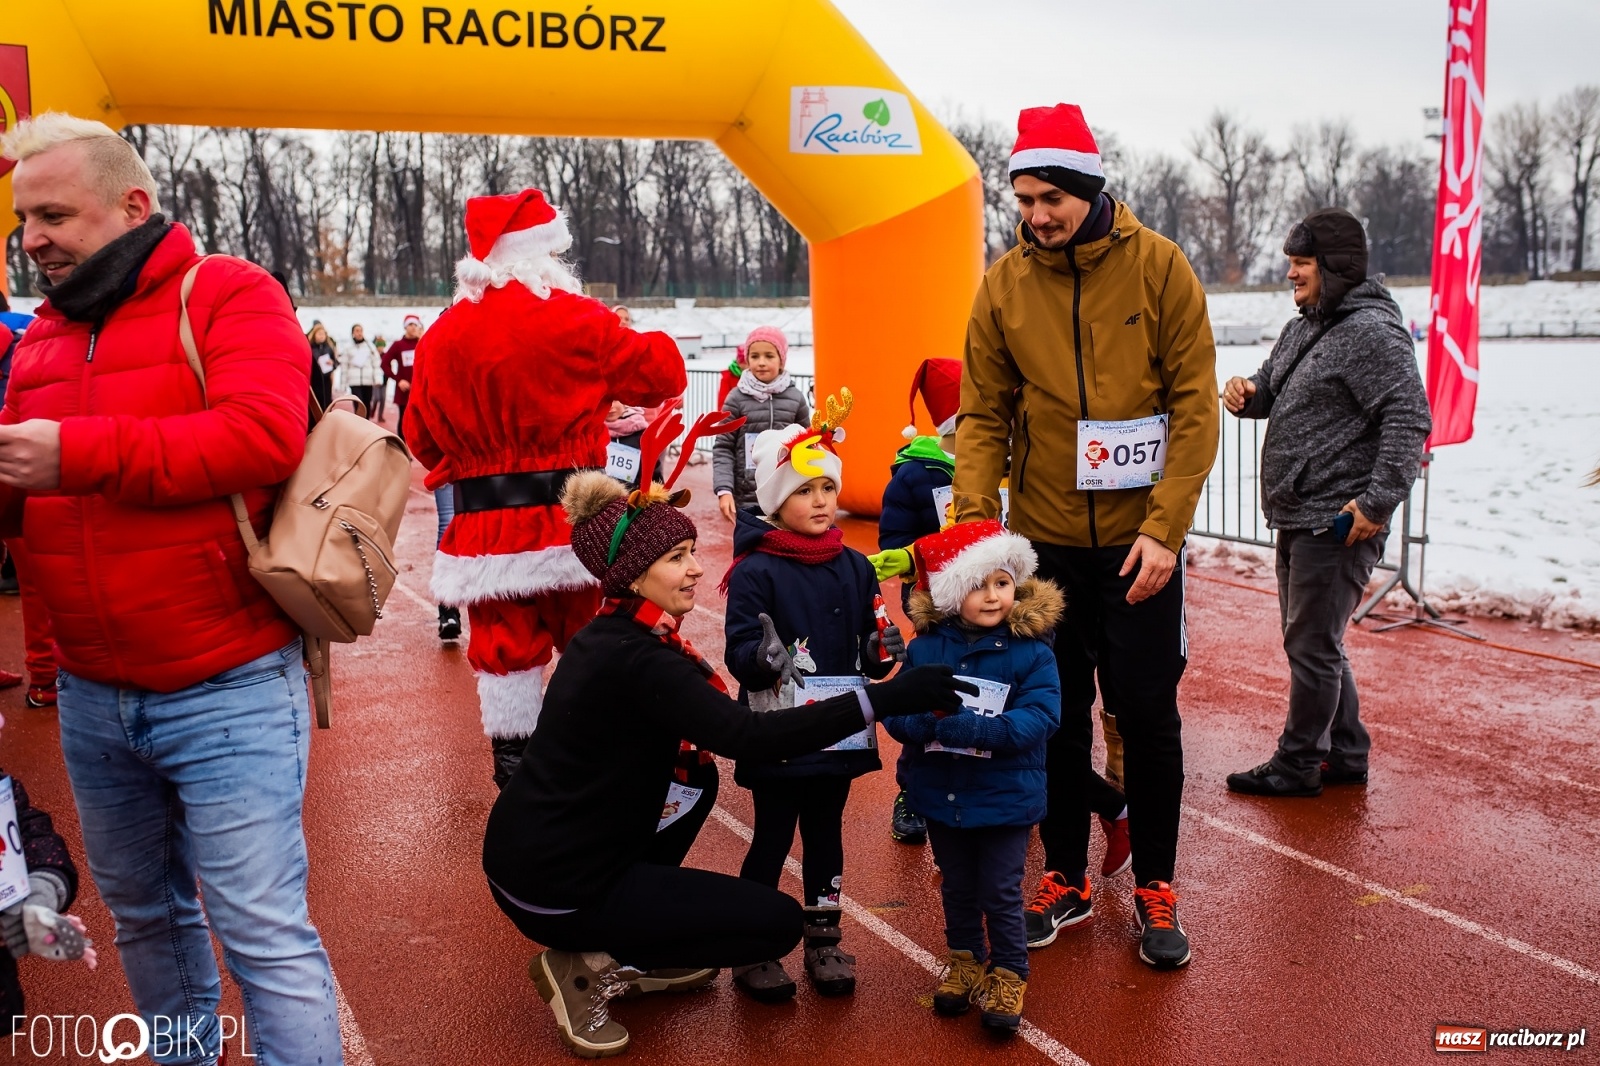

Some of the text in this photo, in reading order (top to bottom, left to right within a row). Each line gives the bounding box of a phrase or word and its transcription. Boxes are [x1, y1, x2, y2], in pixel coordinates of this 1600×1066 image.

[208, 0, 667, 52] MIASTO RACIBÓRZ
[1125, 312, 1141, 325] 4F
[610, 455, 633, 470] 185
[1113, 439, 1161, 467] 057
